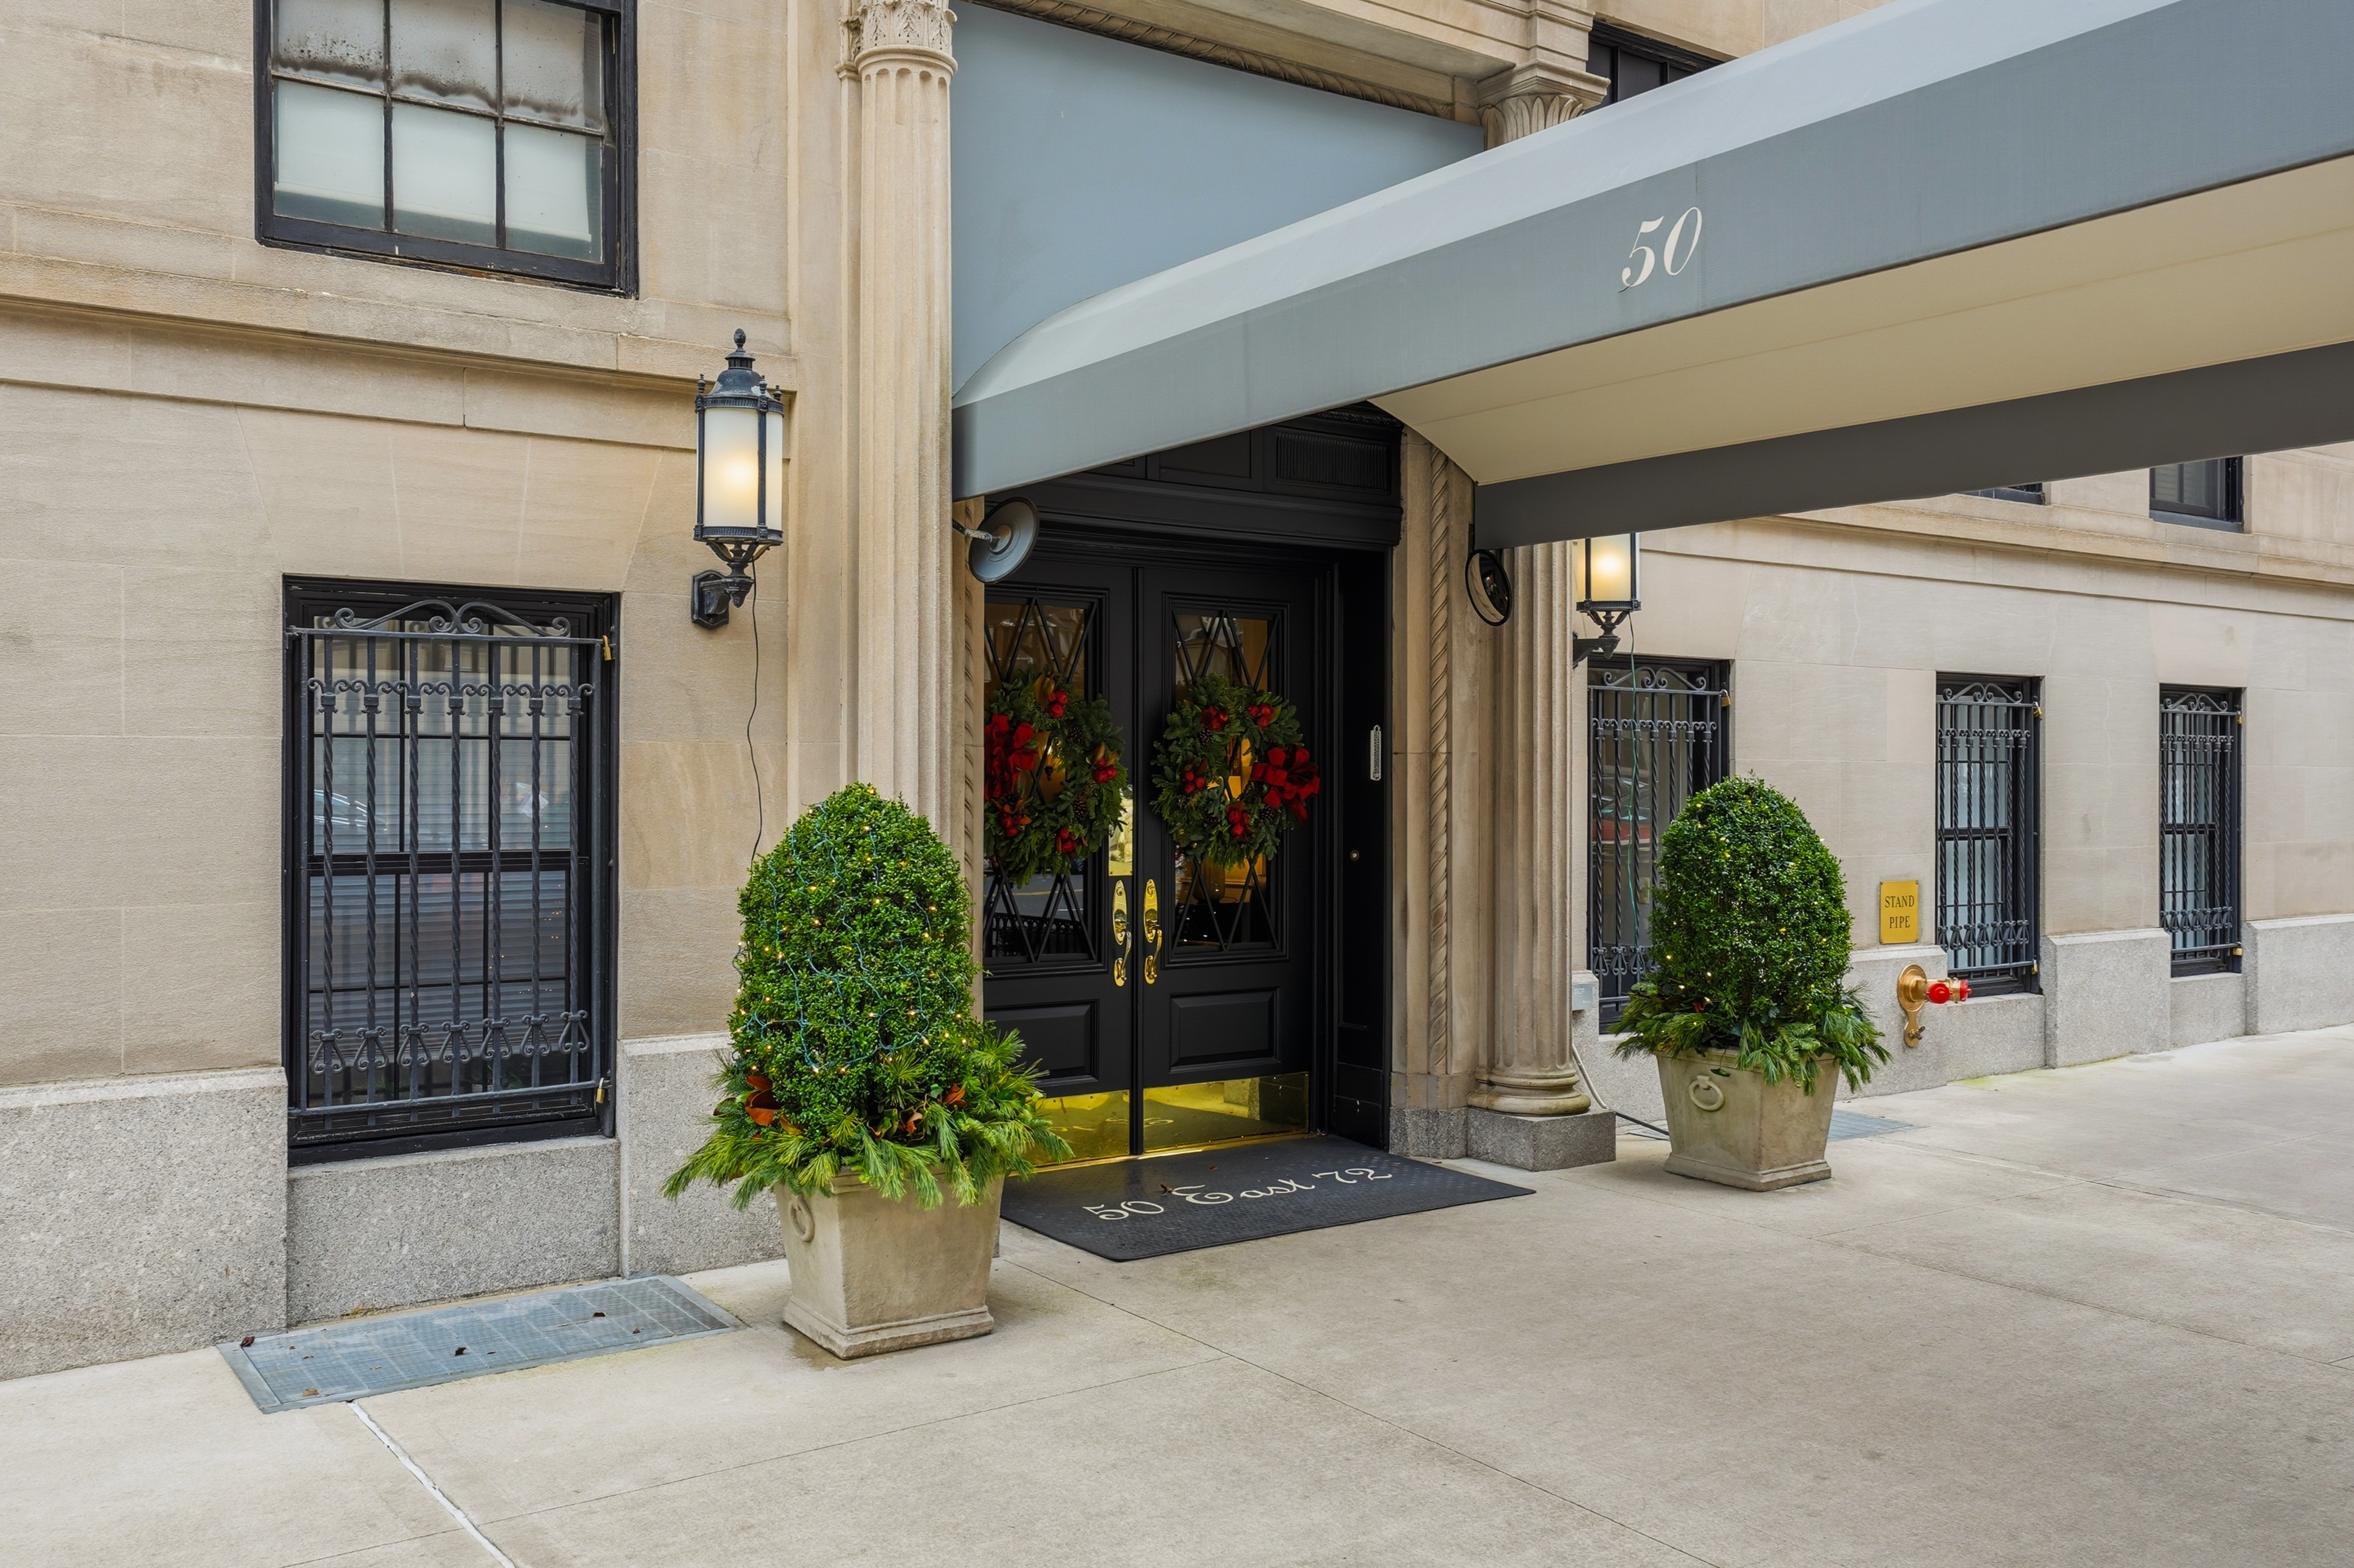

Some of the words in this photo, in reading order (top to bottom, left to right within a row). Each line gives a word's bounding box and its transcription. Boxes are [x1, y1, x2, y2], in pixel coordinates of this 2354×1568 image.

[1621, 206, 1702, 287] 50
[1885, 895, 1914, 908] STAND
[1889, 915, 1910, 928] PIPE
[1082, 1201, 1164, 1220] 50
[1171, 1179, 1315, 1204] East
[1311, 1168, 1393, 1184] 72
